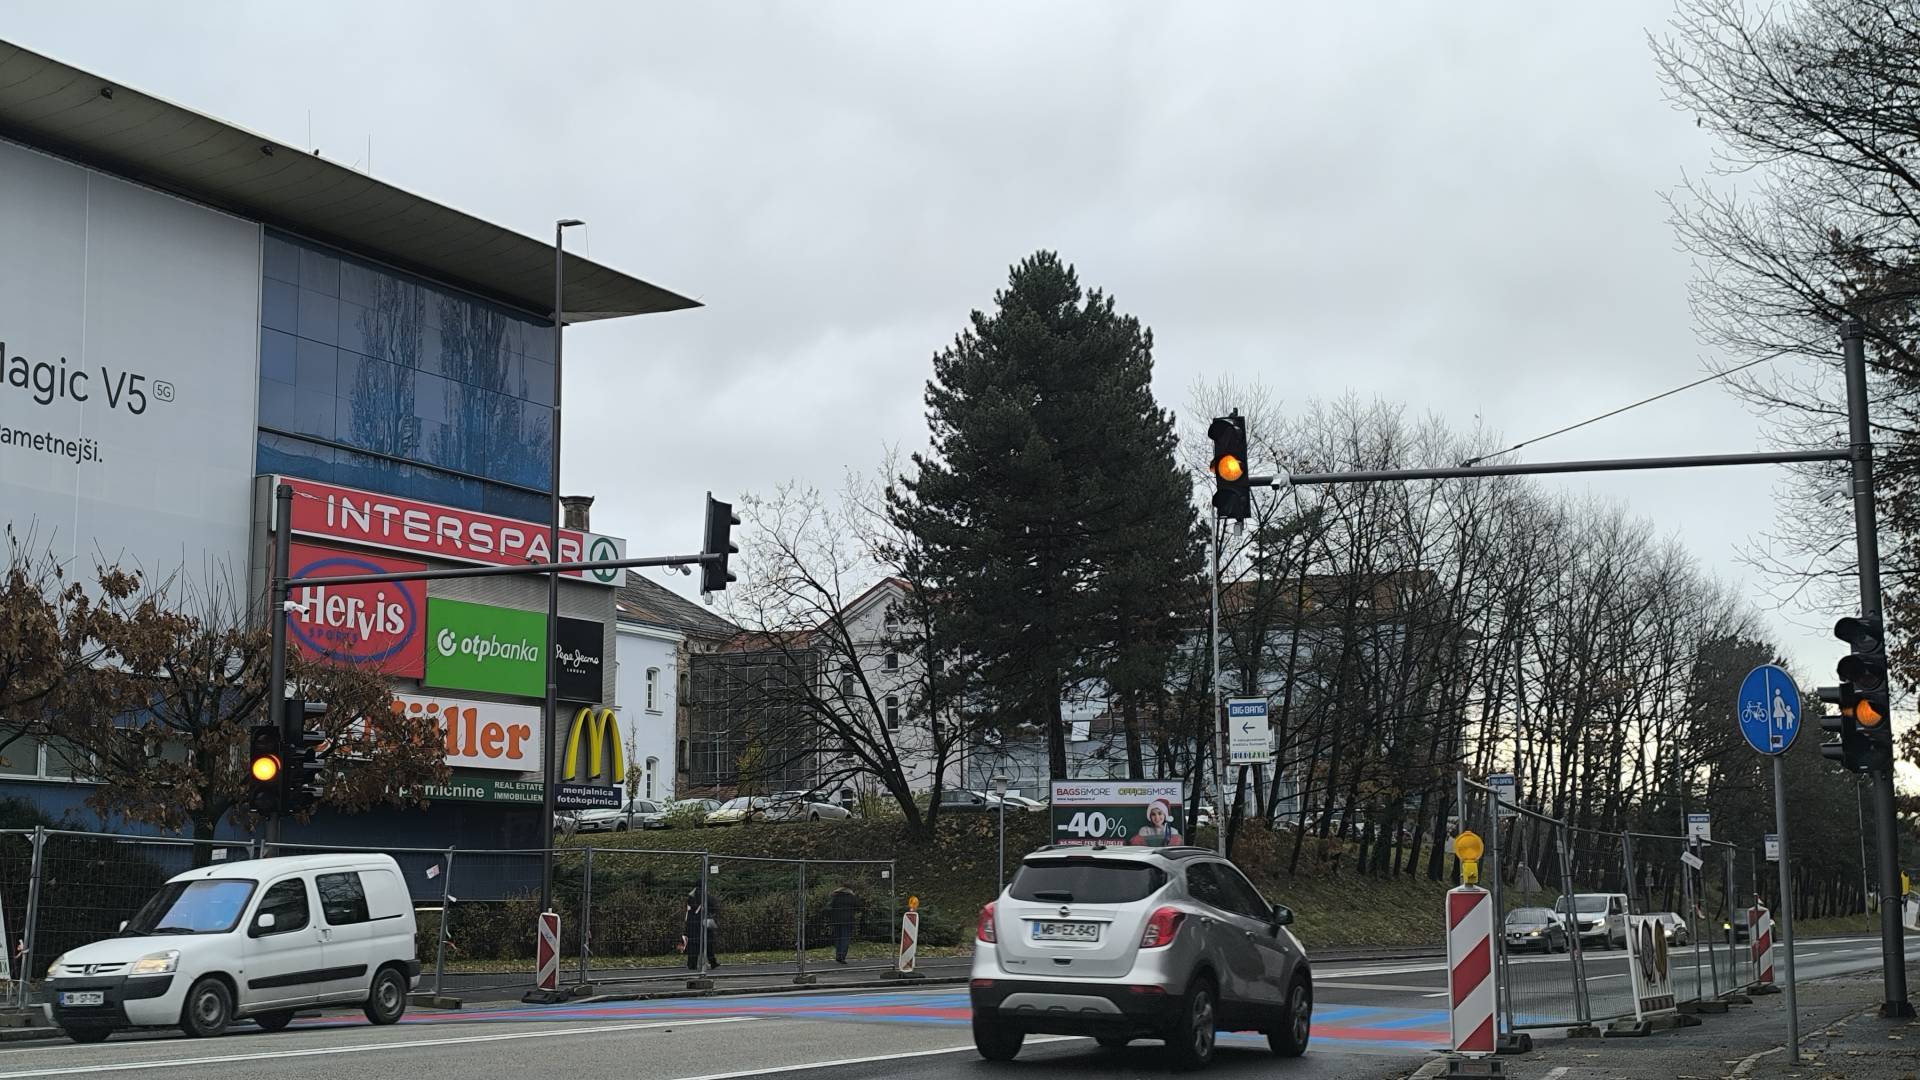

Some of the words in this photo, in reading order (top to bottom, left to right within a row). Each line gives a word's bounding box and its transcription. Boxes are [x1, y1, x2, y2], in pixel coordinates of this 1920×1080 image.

[0, 341, 90, 405] agic
[101, 366, 147, 415] V5
[156, 384, 171, 398] 5G
[0, 424, 103, 464] ametnejši.
[327, 494, 581, 563] INTERSPAR
[301, 585, 405, 641] Hervis
[461, 633, 538, 663] otpbanka
[556, 644, 574, 666] Pepe
[573, 649, 600, 668] Jeans
[1232, 706, 1244, 714] BIG
[1245, 705, 1264, 714] BANG
[494, 781, 514, 790] REAL
[515, 782, 544, 791] ESTATE
[562, 786, 614, 797] menjalnica
[556, 795, 619, 807] fotokopirnica
[1057, 811, 1128, 839] -40%
